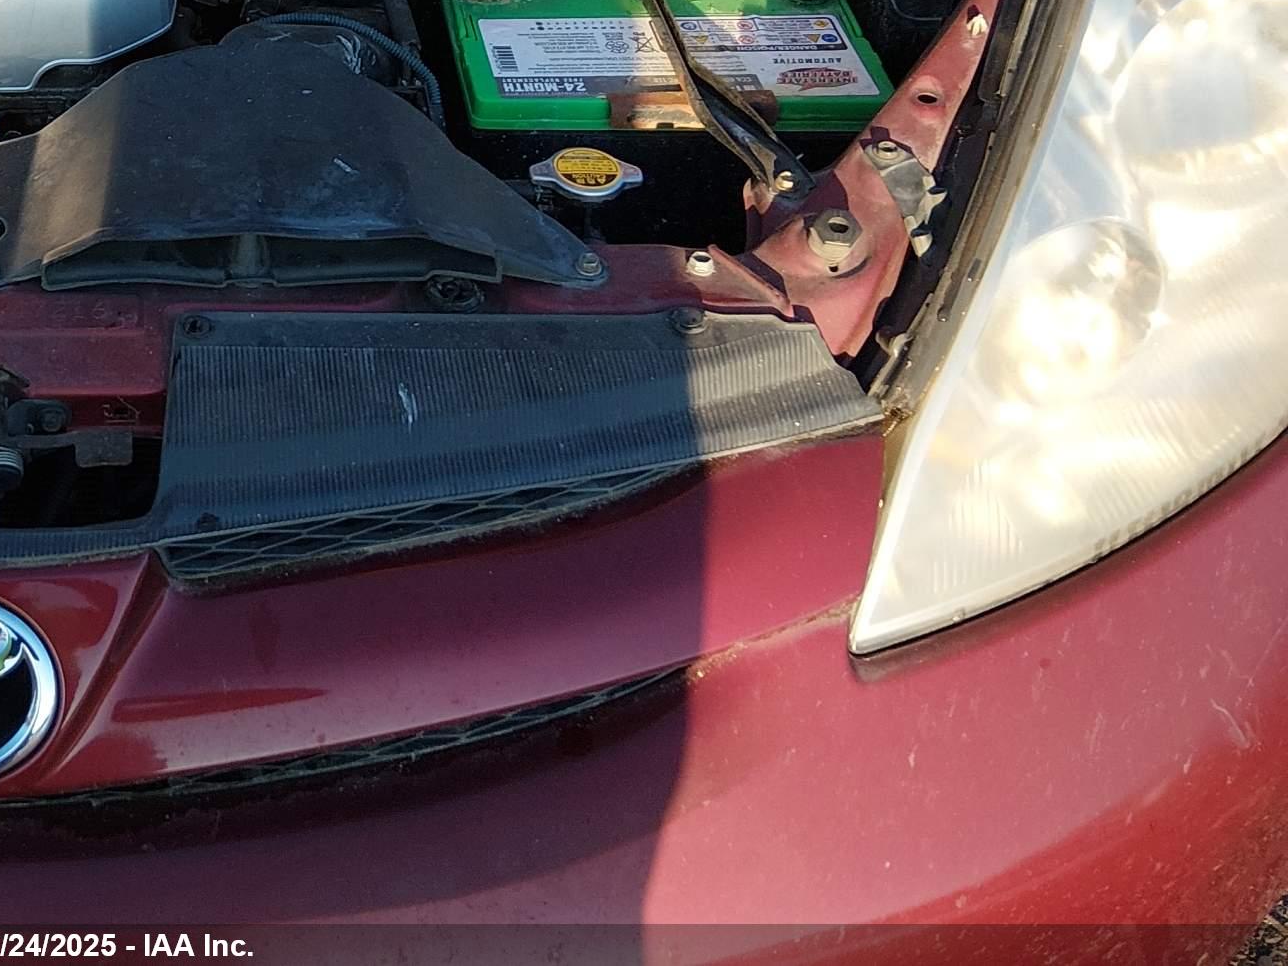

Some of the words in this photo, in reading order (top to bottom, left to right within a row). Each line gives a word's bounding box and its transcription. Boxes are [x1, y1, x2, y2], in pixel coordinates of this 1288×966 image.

[771, 56, 842, 65] AUTOMOTIVE
[778, 70, 853, 78] BATTERIES
[775, 76, 859, 84] INTERSTATE
[502, 82, 587, 93] 24-MONTH
